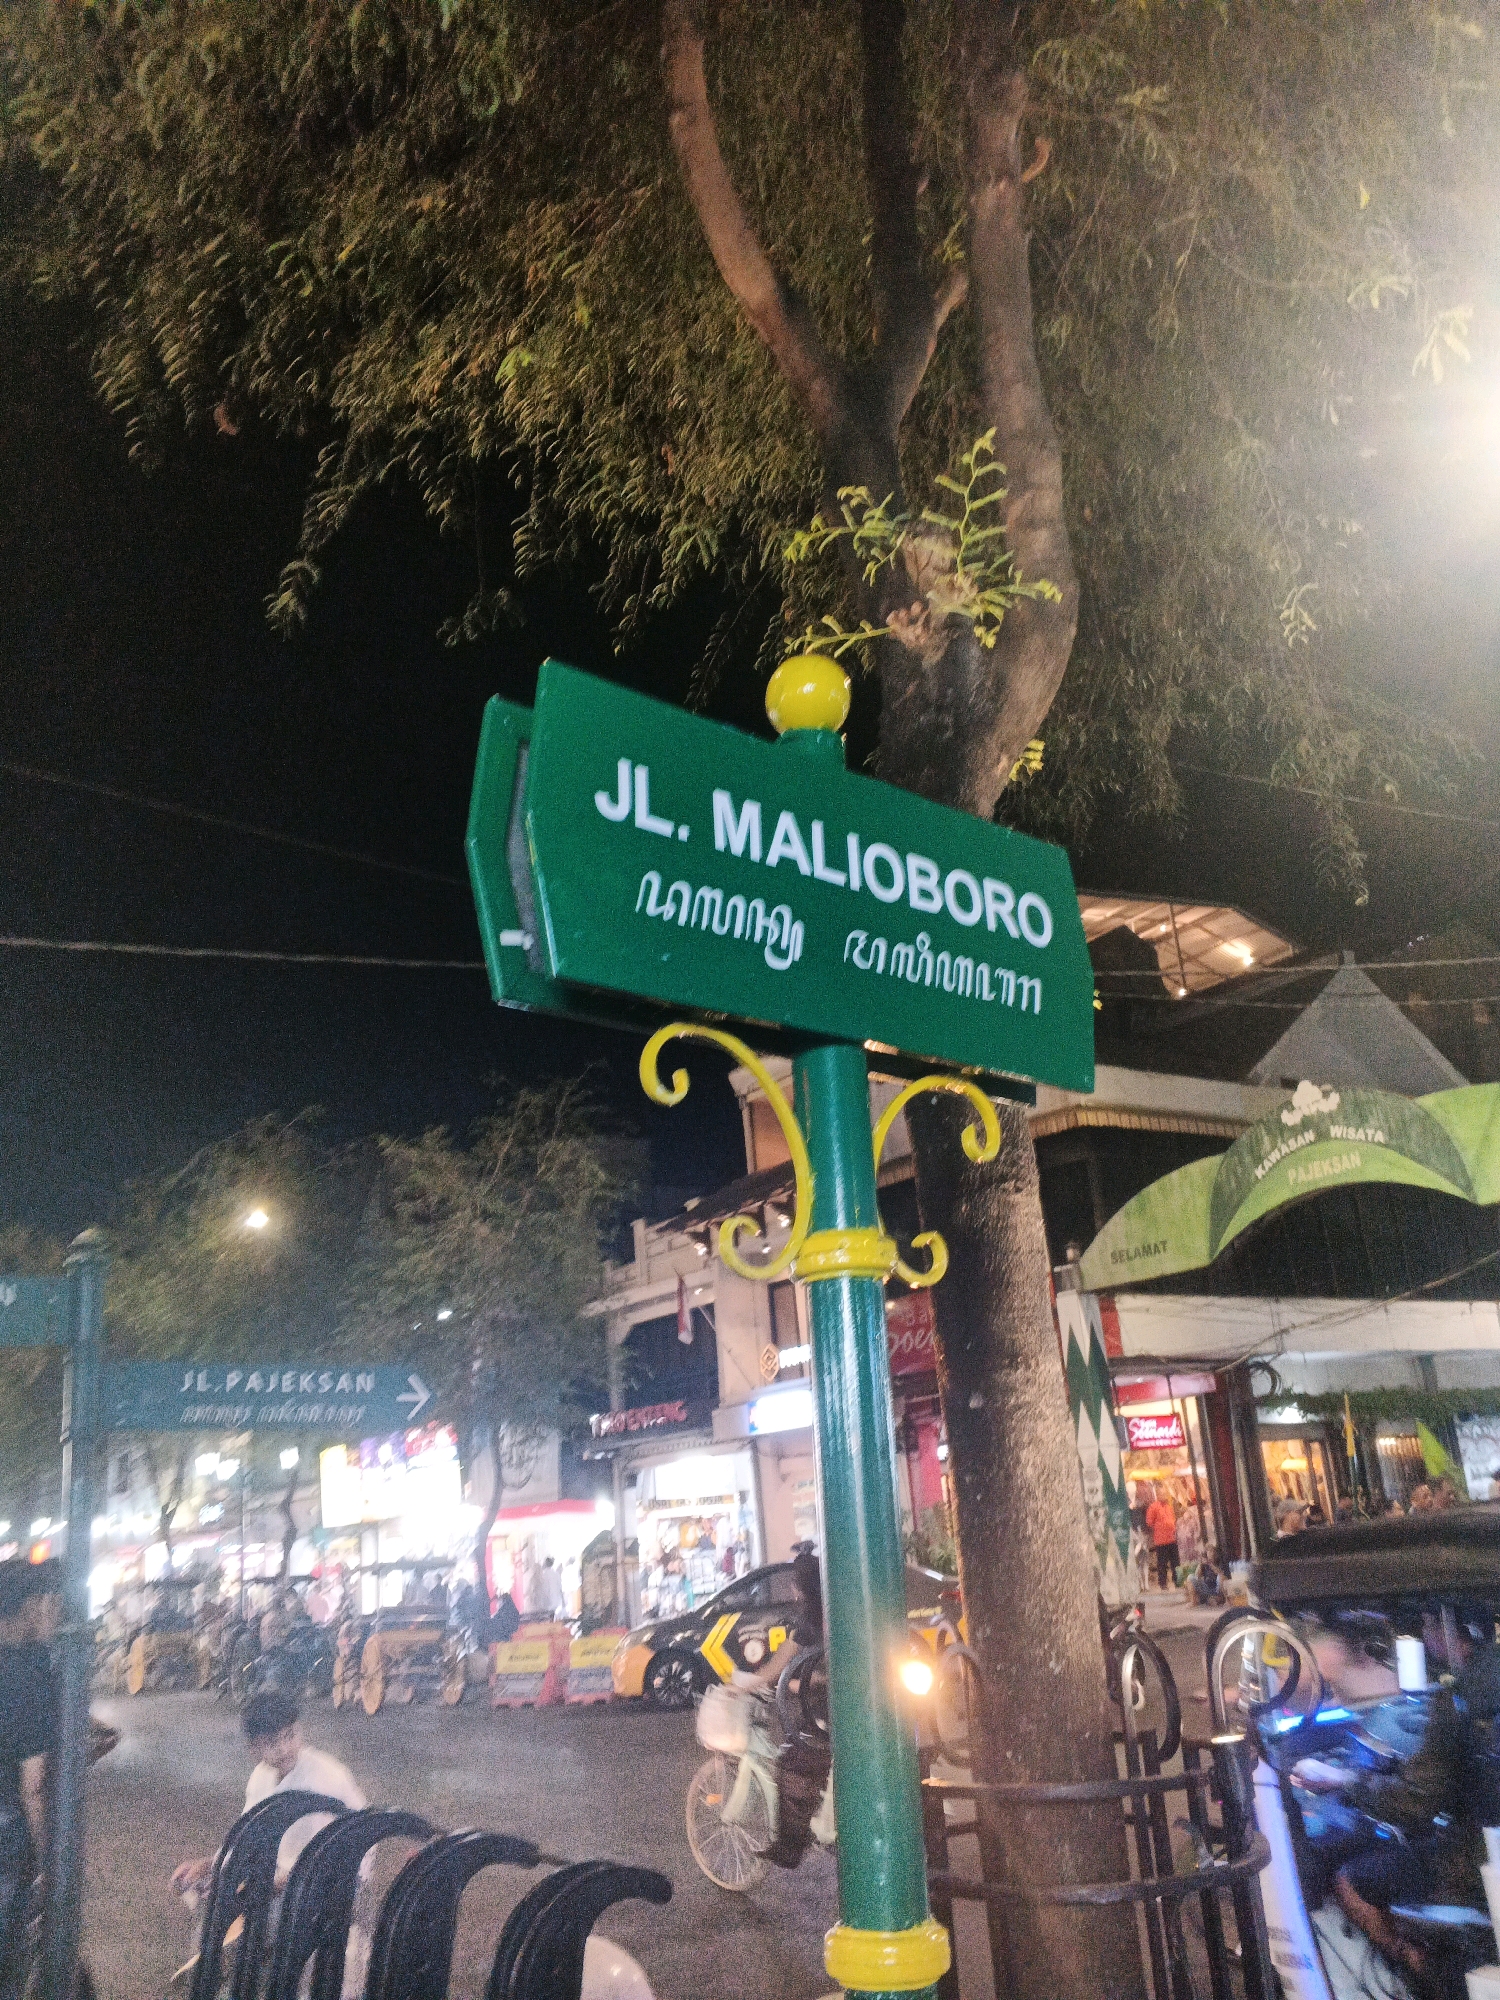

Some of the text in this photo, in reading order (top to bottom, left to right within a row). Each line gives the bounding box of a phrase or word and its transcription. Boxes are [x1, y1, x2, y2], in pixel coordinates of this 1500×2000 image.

[594, 757, 1054, 948] JL. MALIOBORO
[1254, 1123, 1386, 1180] KAWASAN WISATA
[1287, 1150, 1362, 1186] PAJEKSAN
[1110, 1239, 1168, 1266] SELAMAT
[226, 1369, 377, 1394] PAJEKSAN
